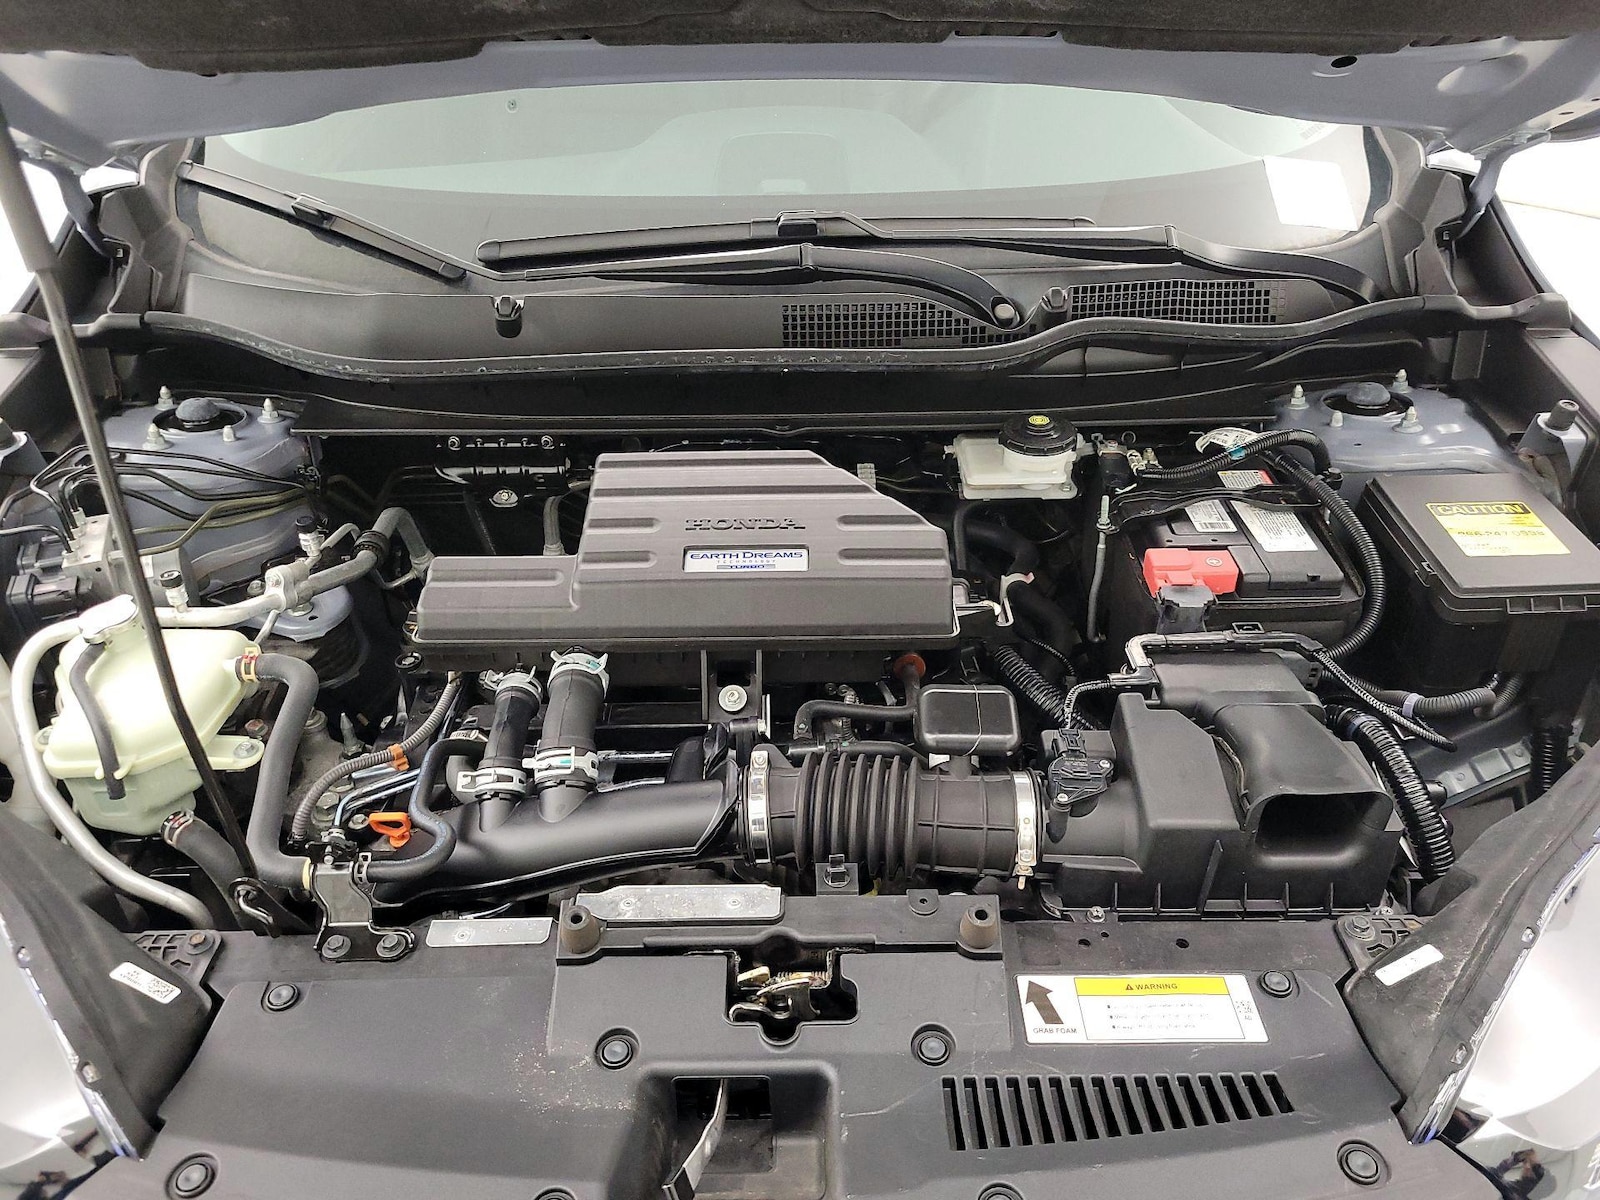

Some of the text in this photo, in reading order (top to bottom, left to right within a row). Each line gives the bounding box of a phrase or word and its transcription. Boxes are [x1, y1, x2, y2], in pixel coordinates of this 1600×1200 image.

[1437, 504, 1525, 515] CAUTION
[684, 518, 806, 531] HONDA
[742, 551, 803, 559] DREAMS
[1135, 983, 1178, 991] WARNING
